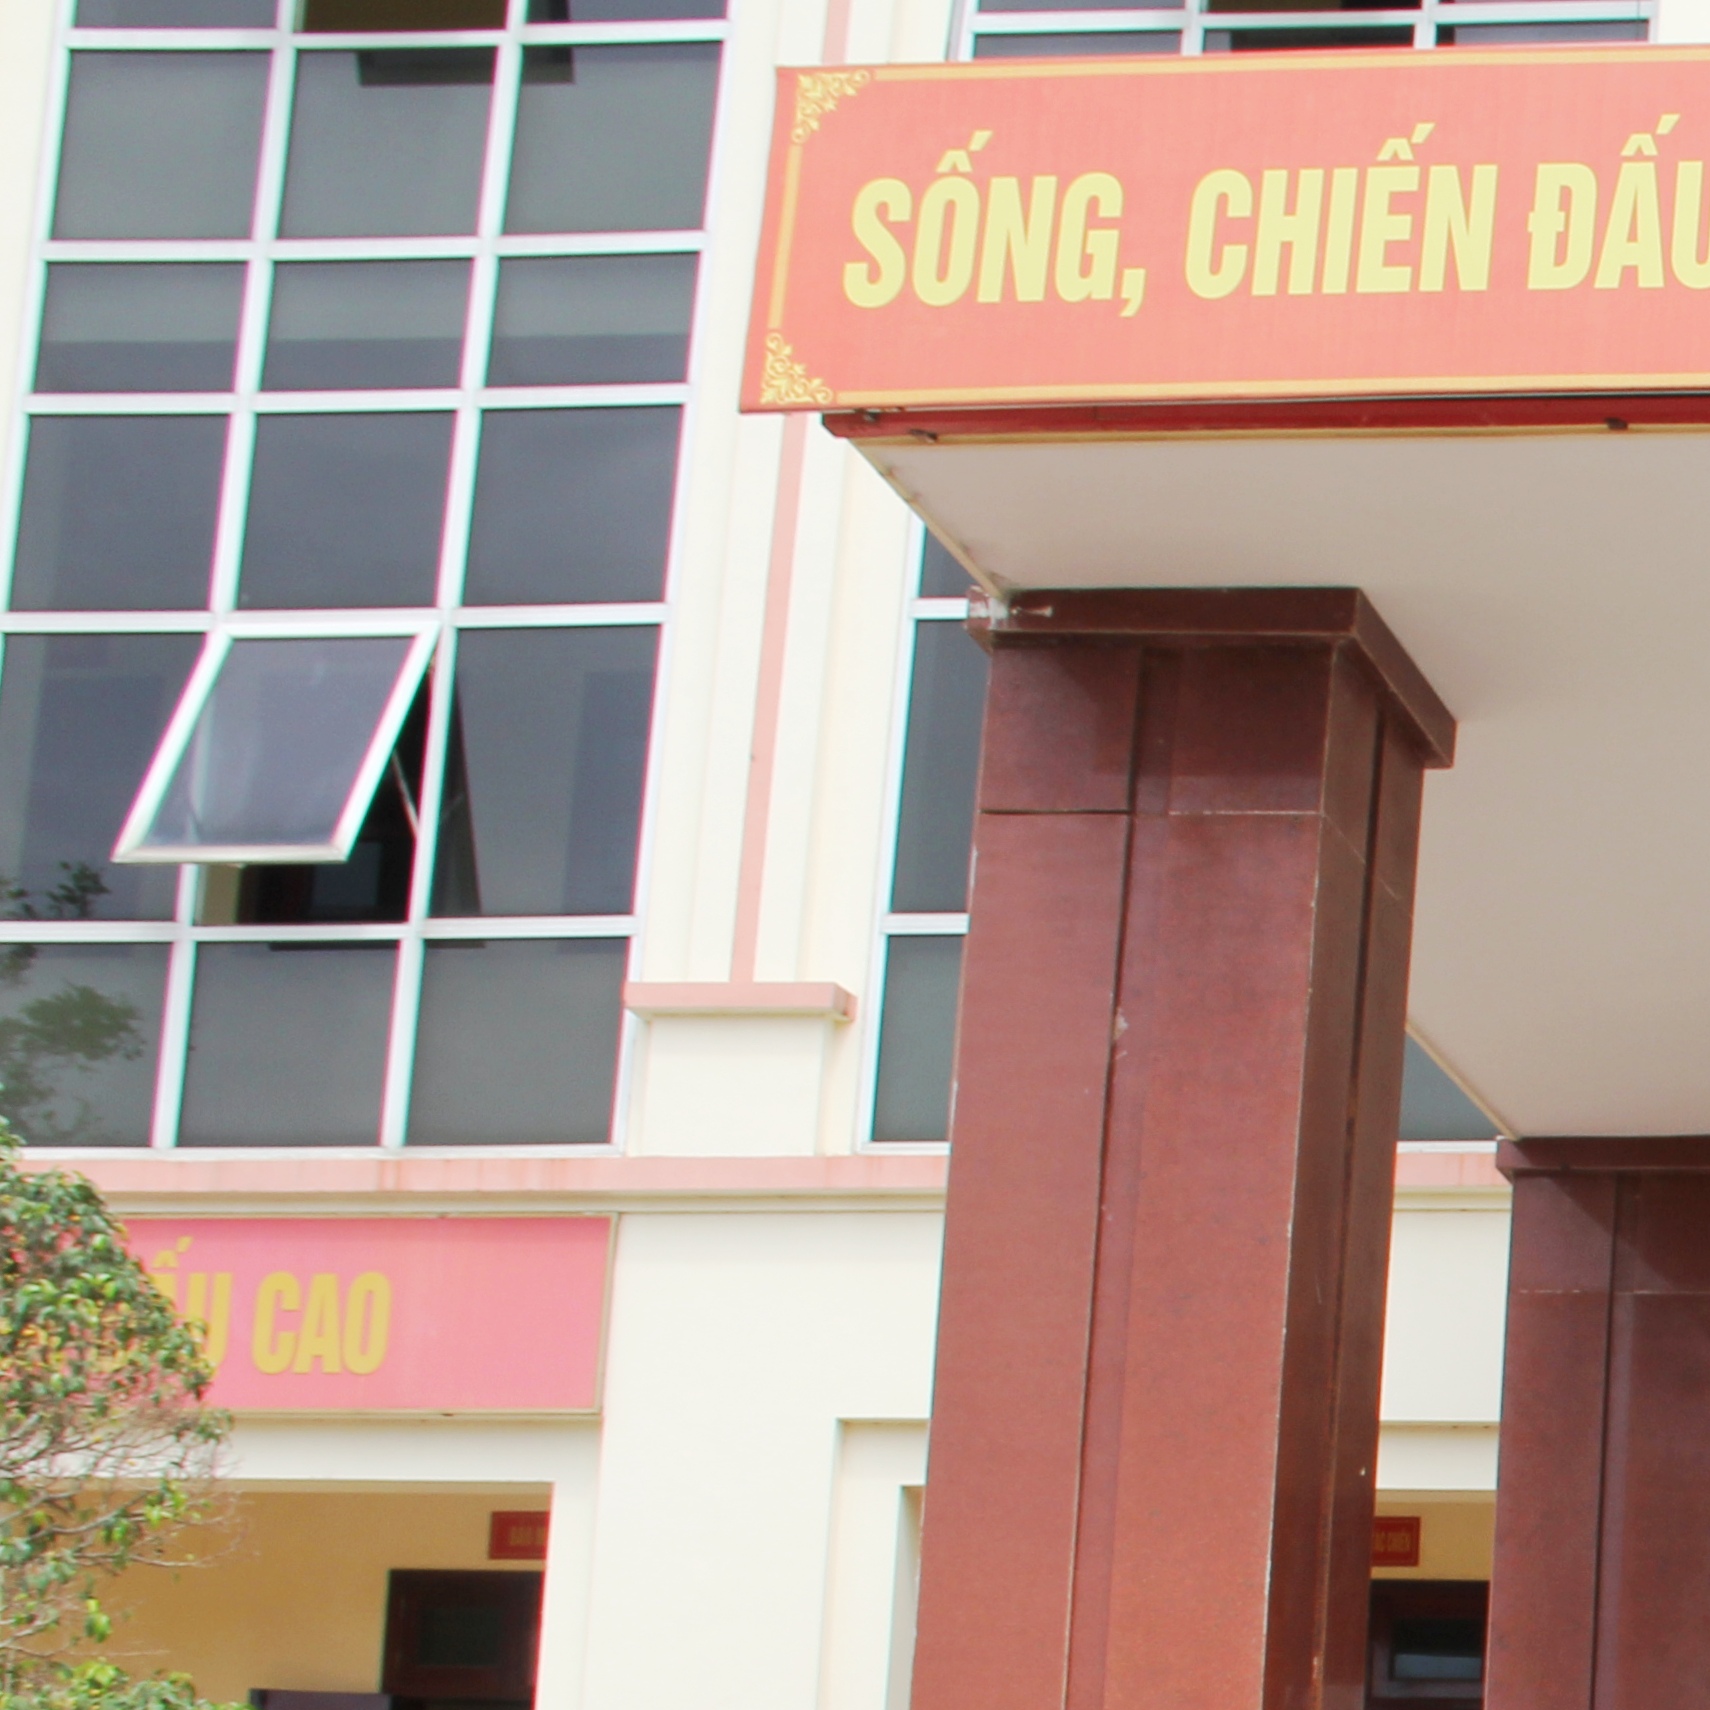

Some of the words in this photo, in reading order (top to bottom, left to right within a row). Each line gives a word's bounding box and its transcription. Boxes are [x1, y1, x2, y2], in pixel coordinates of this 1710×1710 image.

[840, 128, 1149, 318] SỐNG,
[1182, 120, 1501, 301] CHIẾN
[252, 1270, 393, 1375] CAO
